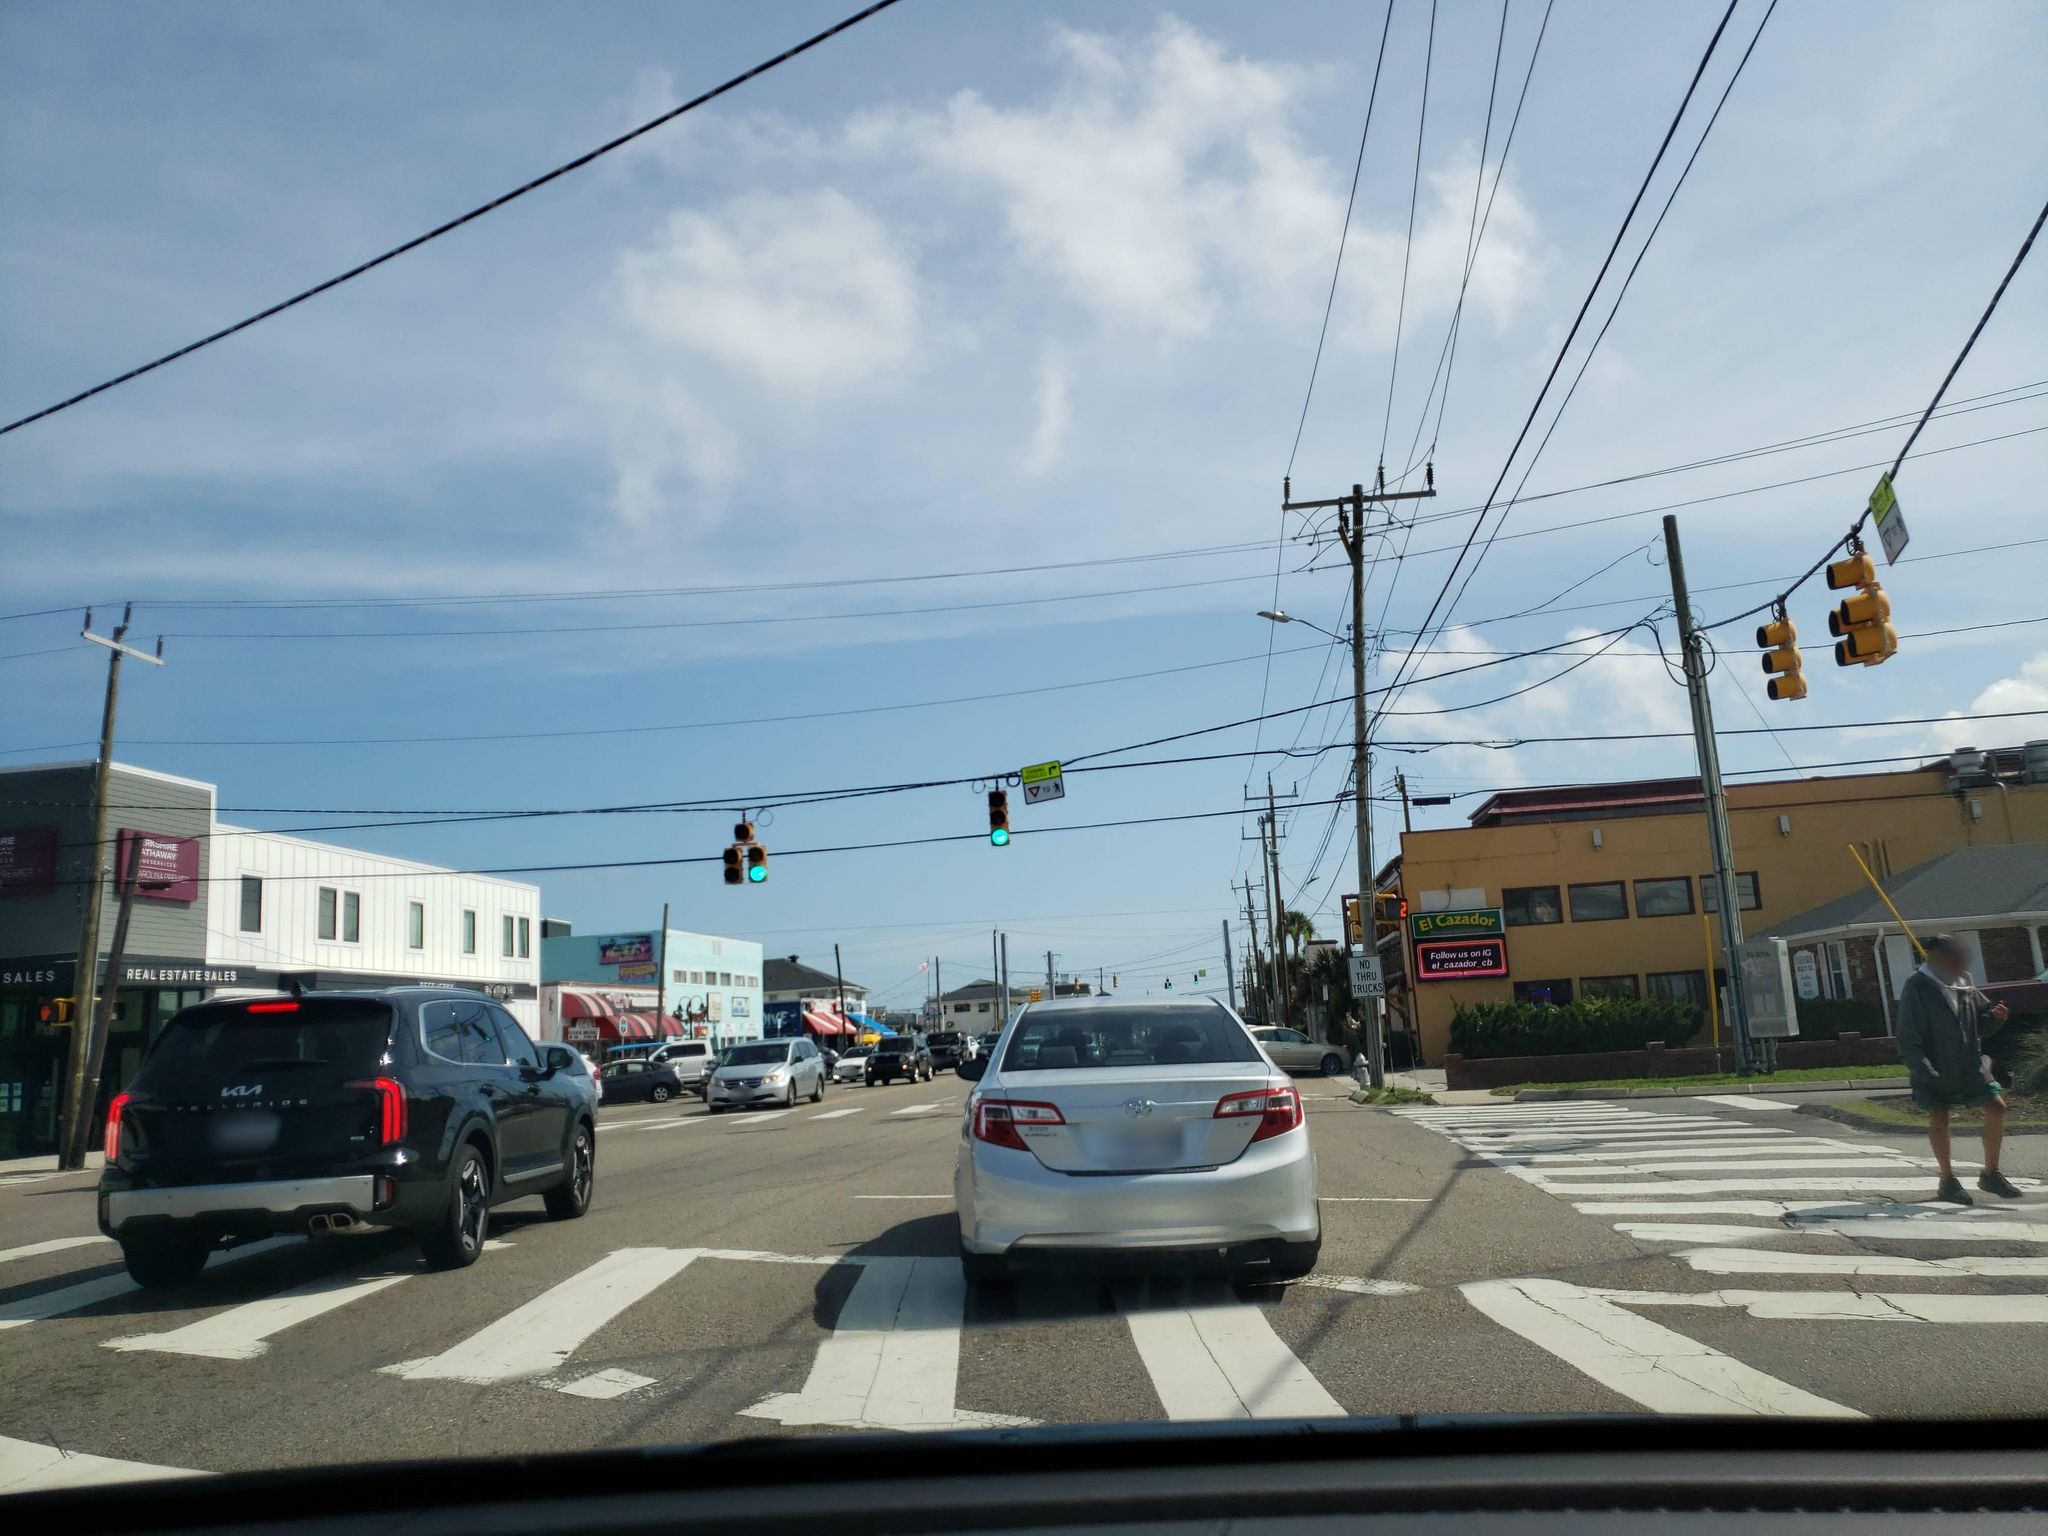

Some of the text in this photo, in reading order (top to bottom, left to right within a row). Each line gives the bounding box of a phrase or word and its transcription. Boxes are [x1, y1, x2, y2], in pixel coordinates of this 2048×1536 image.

[141, 847, 177, 861] ATHAWAY
[138, 869, 163, 880] AROLINA
[1418, 912, 1496, 932] El Cazador
[1430, 951, 1457, 960] Follow
[1482, 949, 1492, 957] IG
[1359, 960, 1371, 970] NO
[1431, 958, 1493, 971] el_cazador_cb
[2, 970, 55, 983] SALES
[126, 968, 237, 981] REAL ESTATE SALES
[1356, 971, 1377, 982] THRU
[1353, 982, 1383, 994] TRUCKS
[220, 1084, 264, 1097] KIA
[176, 1099, 308, 1112] TELLURIDE
